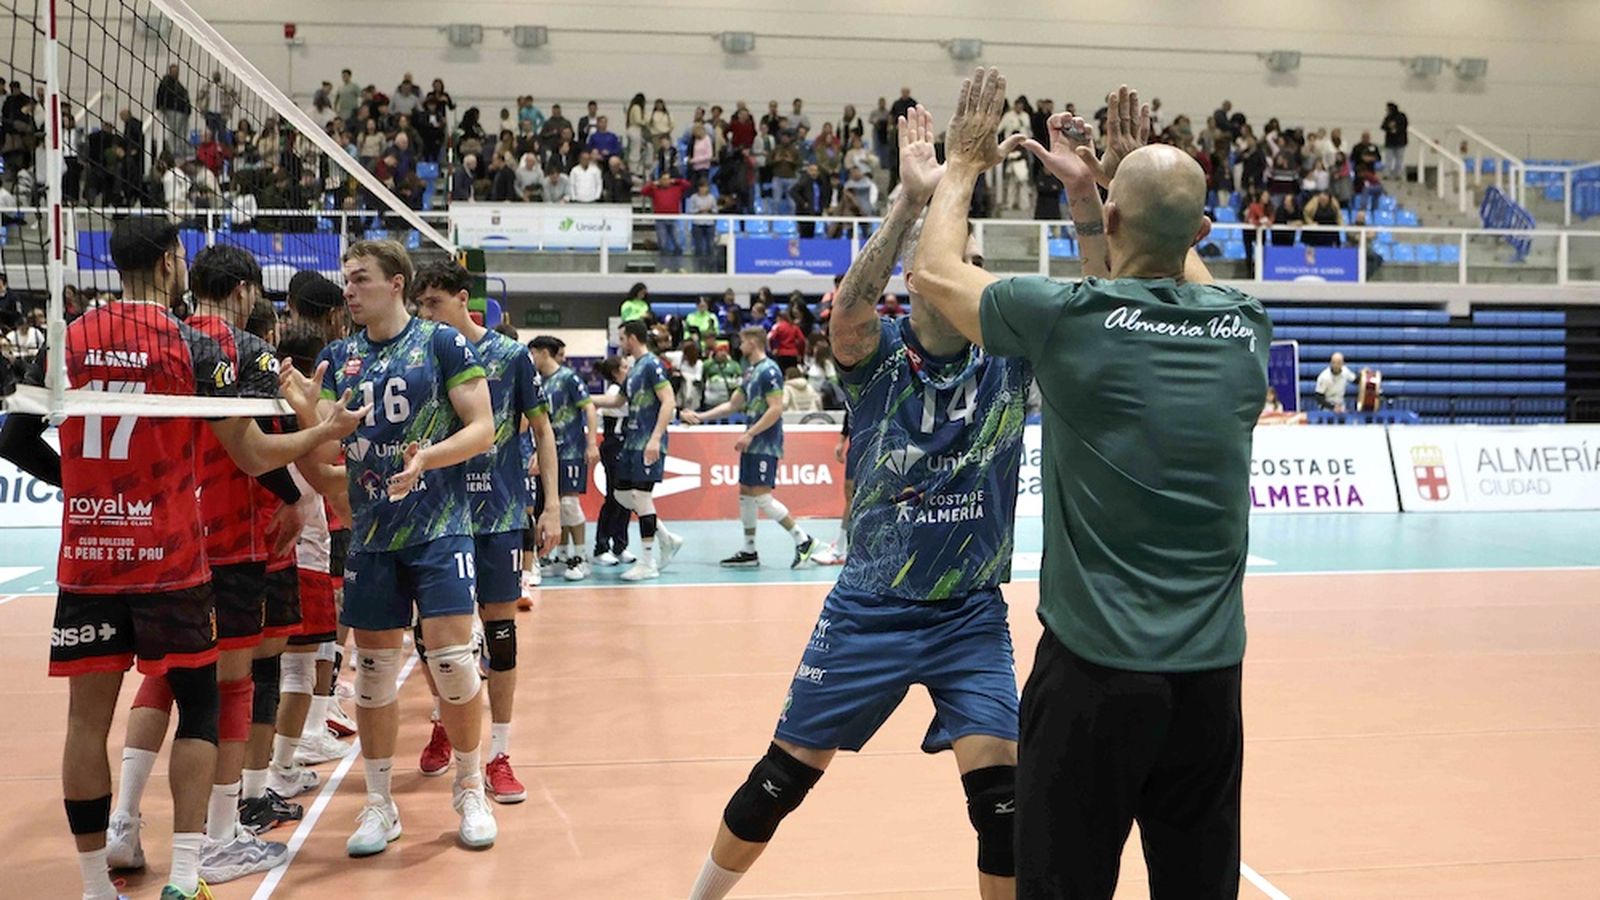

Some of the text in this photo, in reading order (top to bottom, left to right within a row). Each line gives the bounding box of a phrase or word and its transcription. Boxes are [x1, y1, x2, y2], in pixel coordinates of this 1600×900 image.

[1206, 313, 1257, 353] Voley
[359, 376, 411, 427] 16
[919, 378, 979, 434] 14
[79, 379, 148, 461] 17
[710, 464, 833, 486] SULIGA
[1479, 478, 1552, 496] CIUDAD
[69, 493, 125, 519] royal
[1250, 478, 1364, 508] LMERÍA
[915, 503, 985, 524] ALMERÍA
[75, 547, 104, 560] PERE
[116, 547, 136, 560] ST.
[138, 547, 164, 560] PAU
[454, 552, 475, 579] 16
